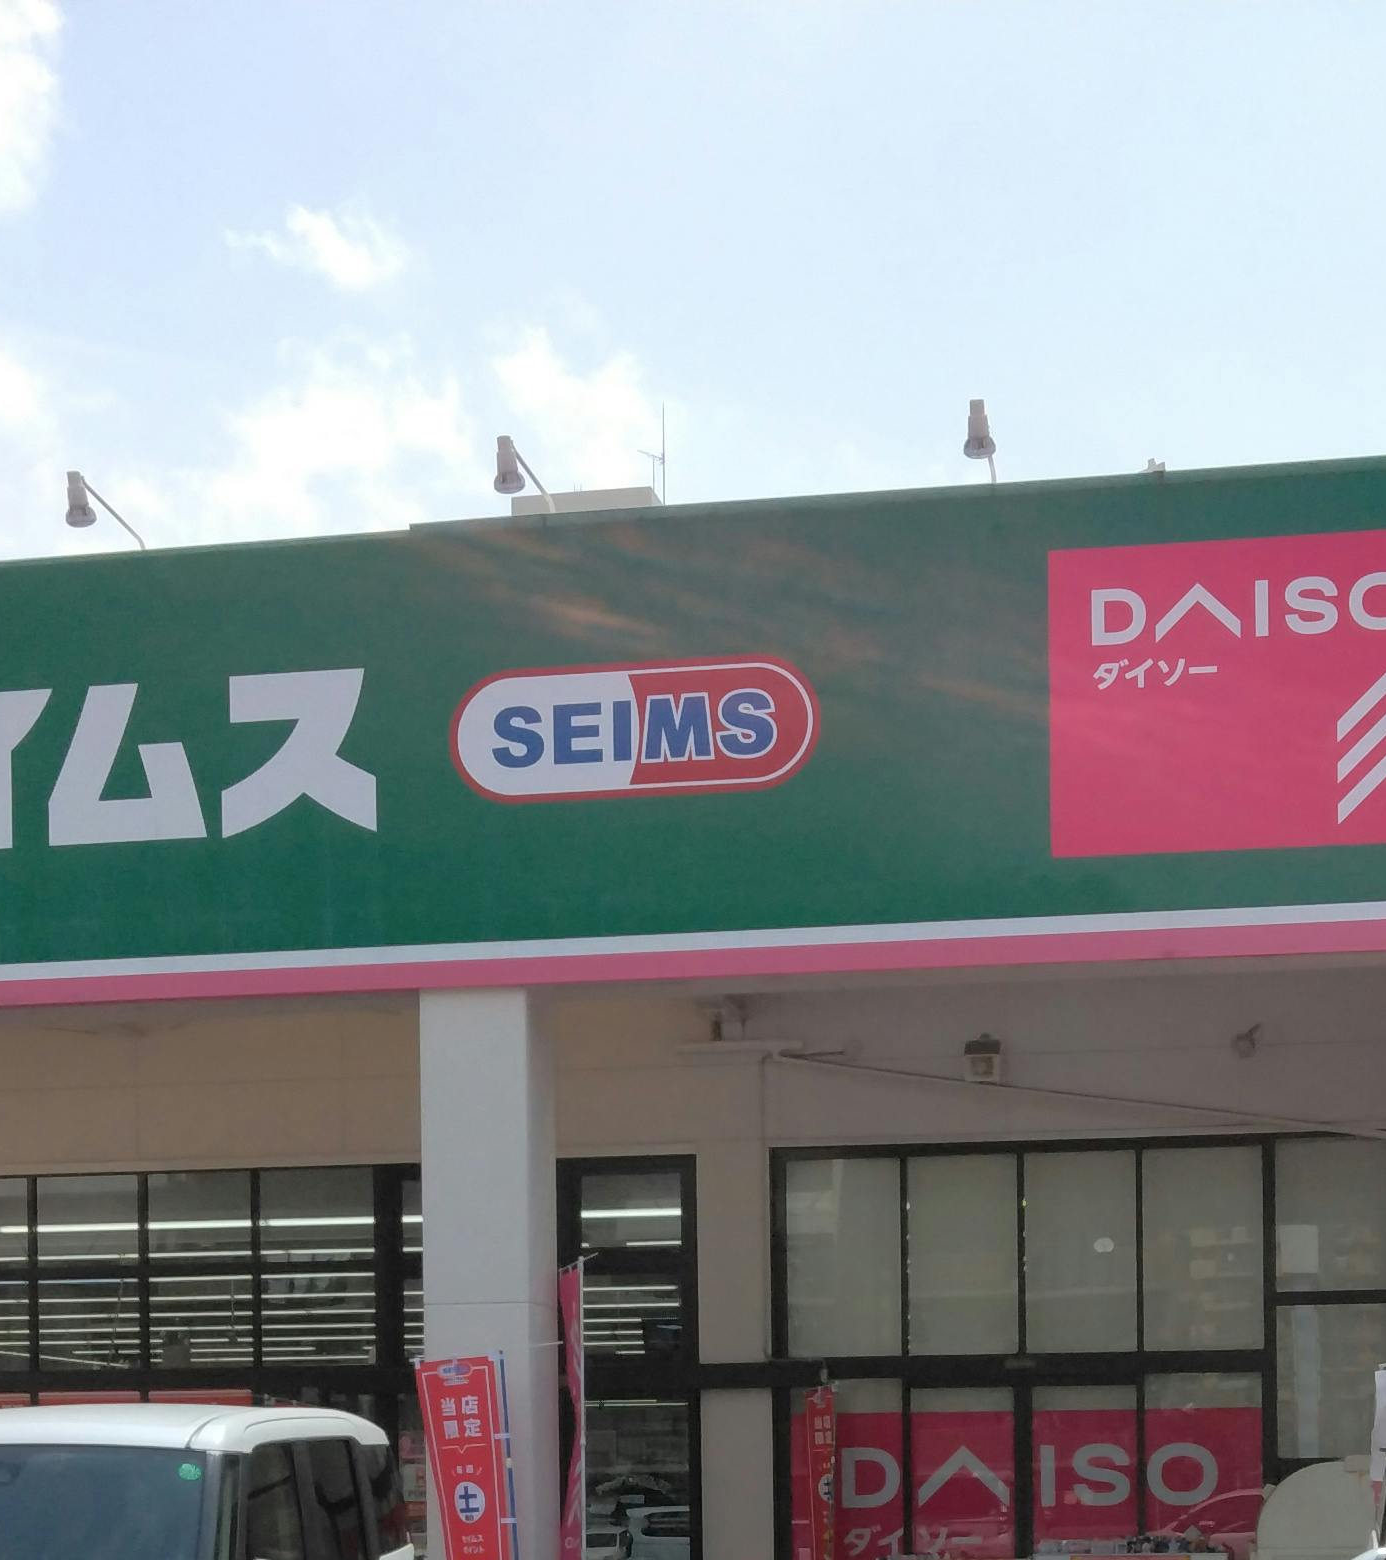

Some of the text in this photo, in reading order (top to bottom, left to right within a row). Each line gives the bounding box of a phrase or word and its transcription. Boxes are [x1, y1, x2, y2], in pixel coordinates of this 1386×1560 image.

[1092, 657, 1218, 690] ダイソー
[491, 686, 778, 770] SEIMS
[841, 1441, 1219, 1509] DAISO
